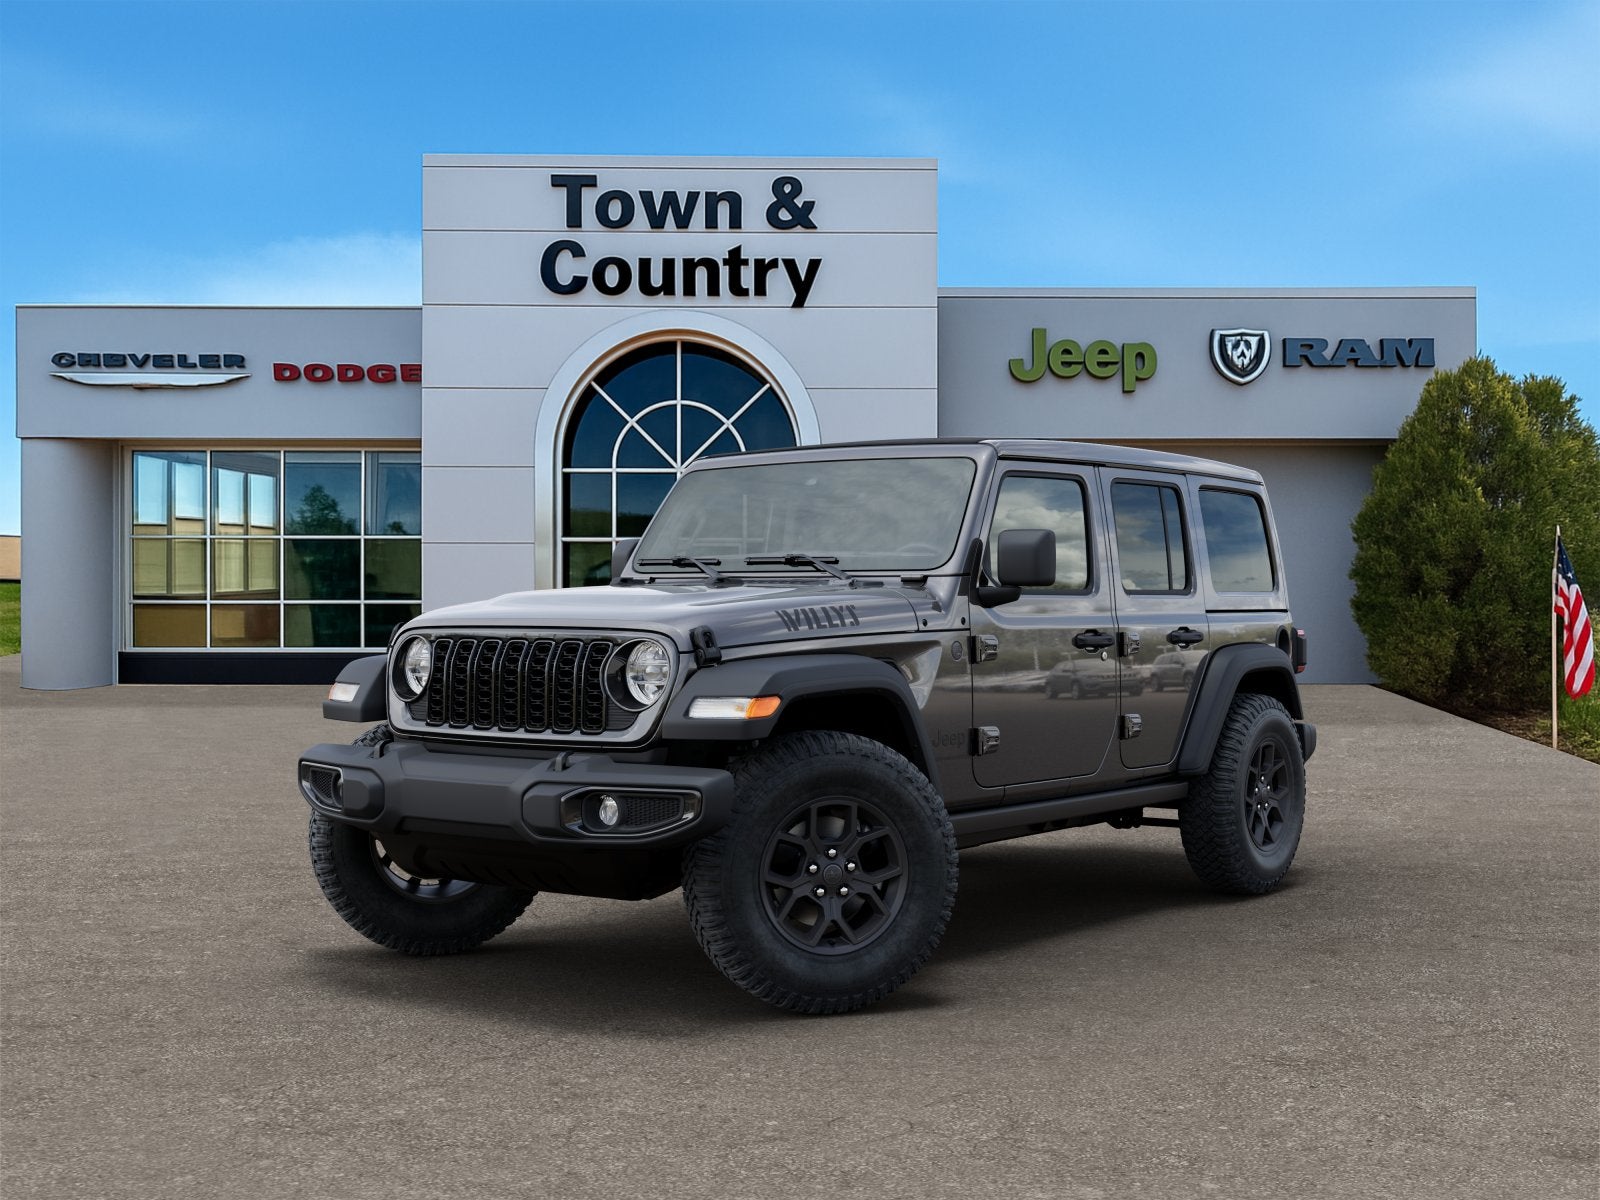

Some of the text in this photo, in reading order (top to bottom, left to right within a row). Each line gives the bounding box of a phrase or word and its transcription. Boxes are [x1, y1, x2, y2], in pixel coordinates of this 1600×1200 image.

[550, 174, 818, 230] Town &
[540, 239, 823, 308] Country
[1008, 327, 1158, 393] Jeep
[1282, 337, 1436, 368] RAM
[272, 362, 422, 383] DODGE
[774, 604, 860, 632] WILLYS
[932, 727, 966, 748] Jeep
